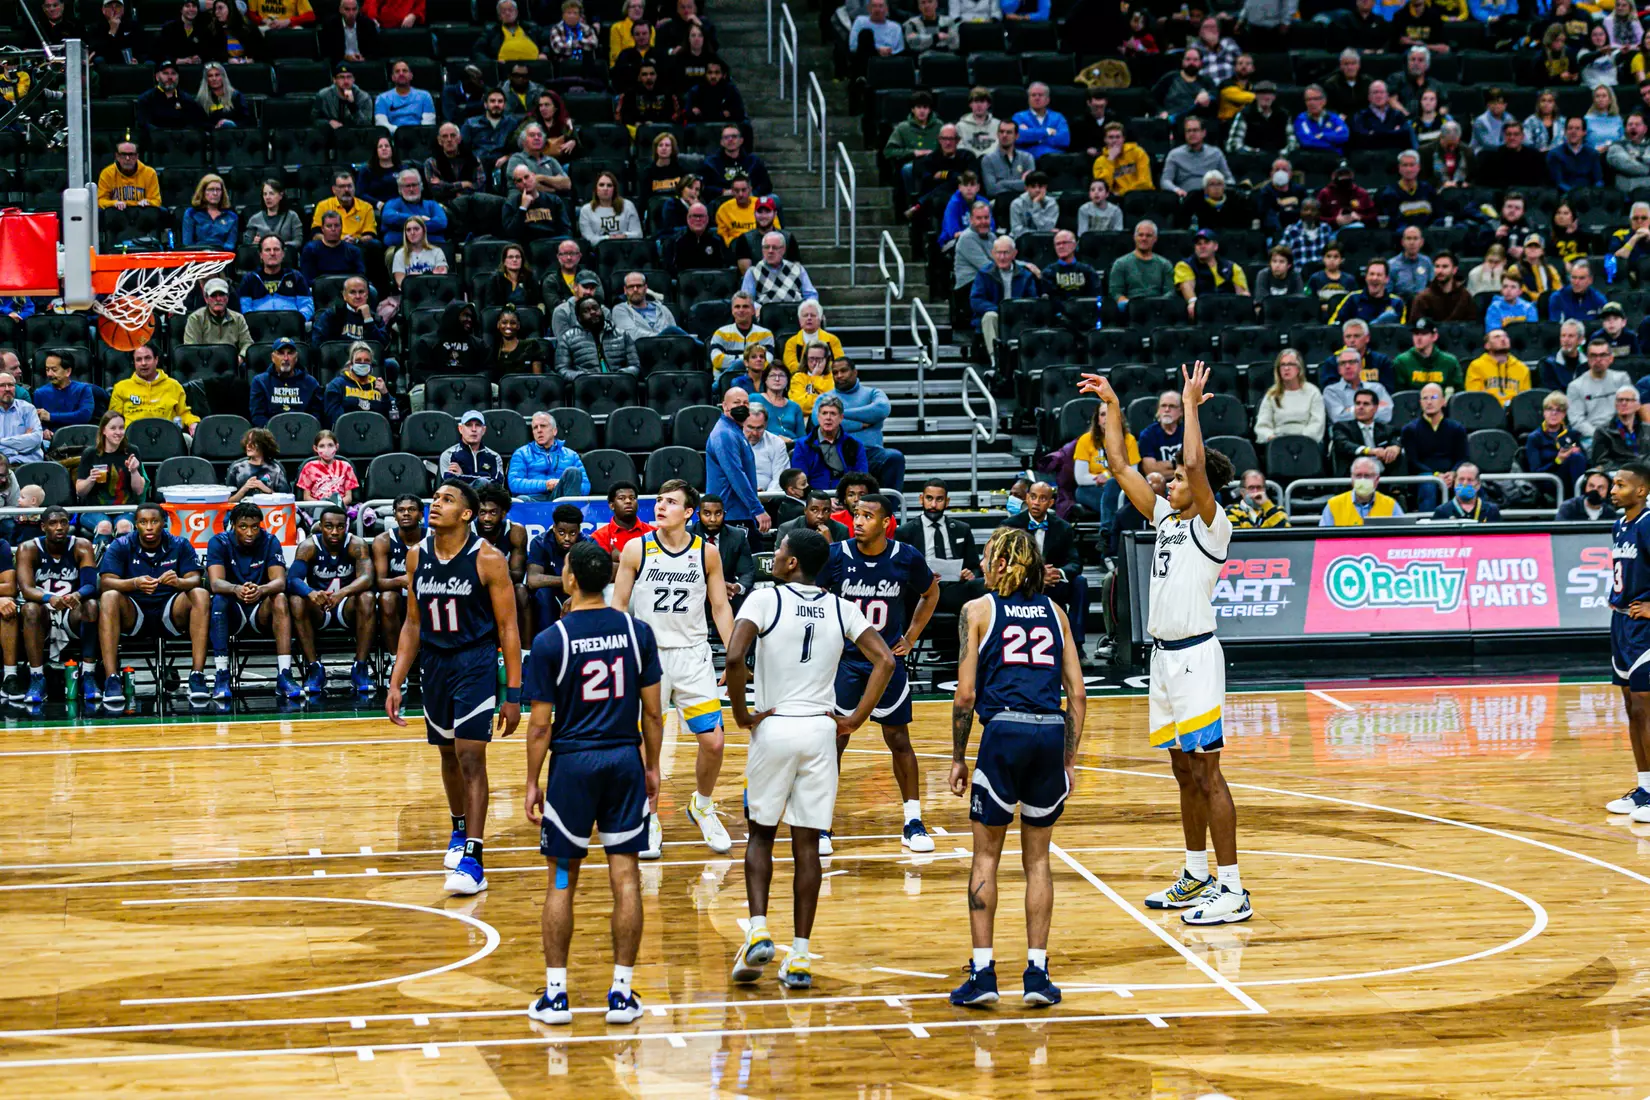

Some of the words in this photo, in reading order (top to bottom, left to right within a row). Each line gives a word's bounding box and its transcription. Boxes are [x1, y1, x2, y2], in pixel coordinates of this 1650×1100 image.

[189, 513, 206, 531] G
[268, 510, 284, 527] G
[1387, 547, 1456, 560] EXCLUSIVELY
[1458, 547, 1473, 558] AT
[646, 568, 700, 586] Marquette
[1218, 558, 1291, 581] PER
[1476, 558, 1539, 582] AUTO
[416, 576, 448, 600] Jackson
[446, 576, 473, 597] State
[841, 578, 877, 597] Jackson
[876, 577, 901, 597] State
[1211, 578, 1296, 602] ART
[1329, 558, 1462, 608] O'Reilly
[653, 586, 690, 614] 22
[1470, 582, 1549, 608] PARTS
[429, 598, 459, 632] 11
[796, 604, 825, 619] JONES
[1003, 604, 1048, 619] MOORE
[1213, 604, 1279, 618] TERIES
[571, 633, 628, 655] FREEMAN
[799, 622, 815, 664] 1
[1002, 624, 1055, 666] 22
[581, 656, 625, 701] 21
